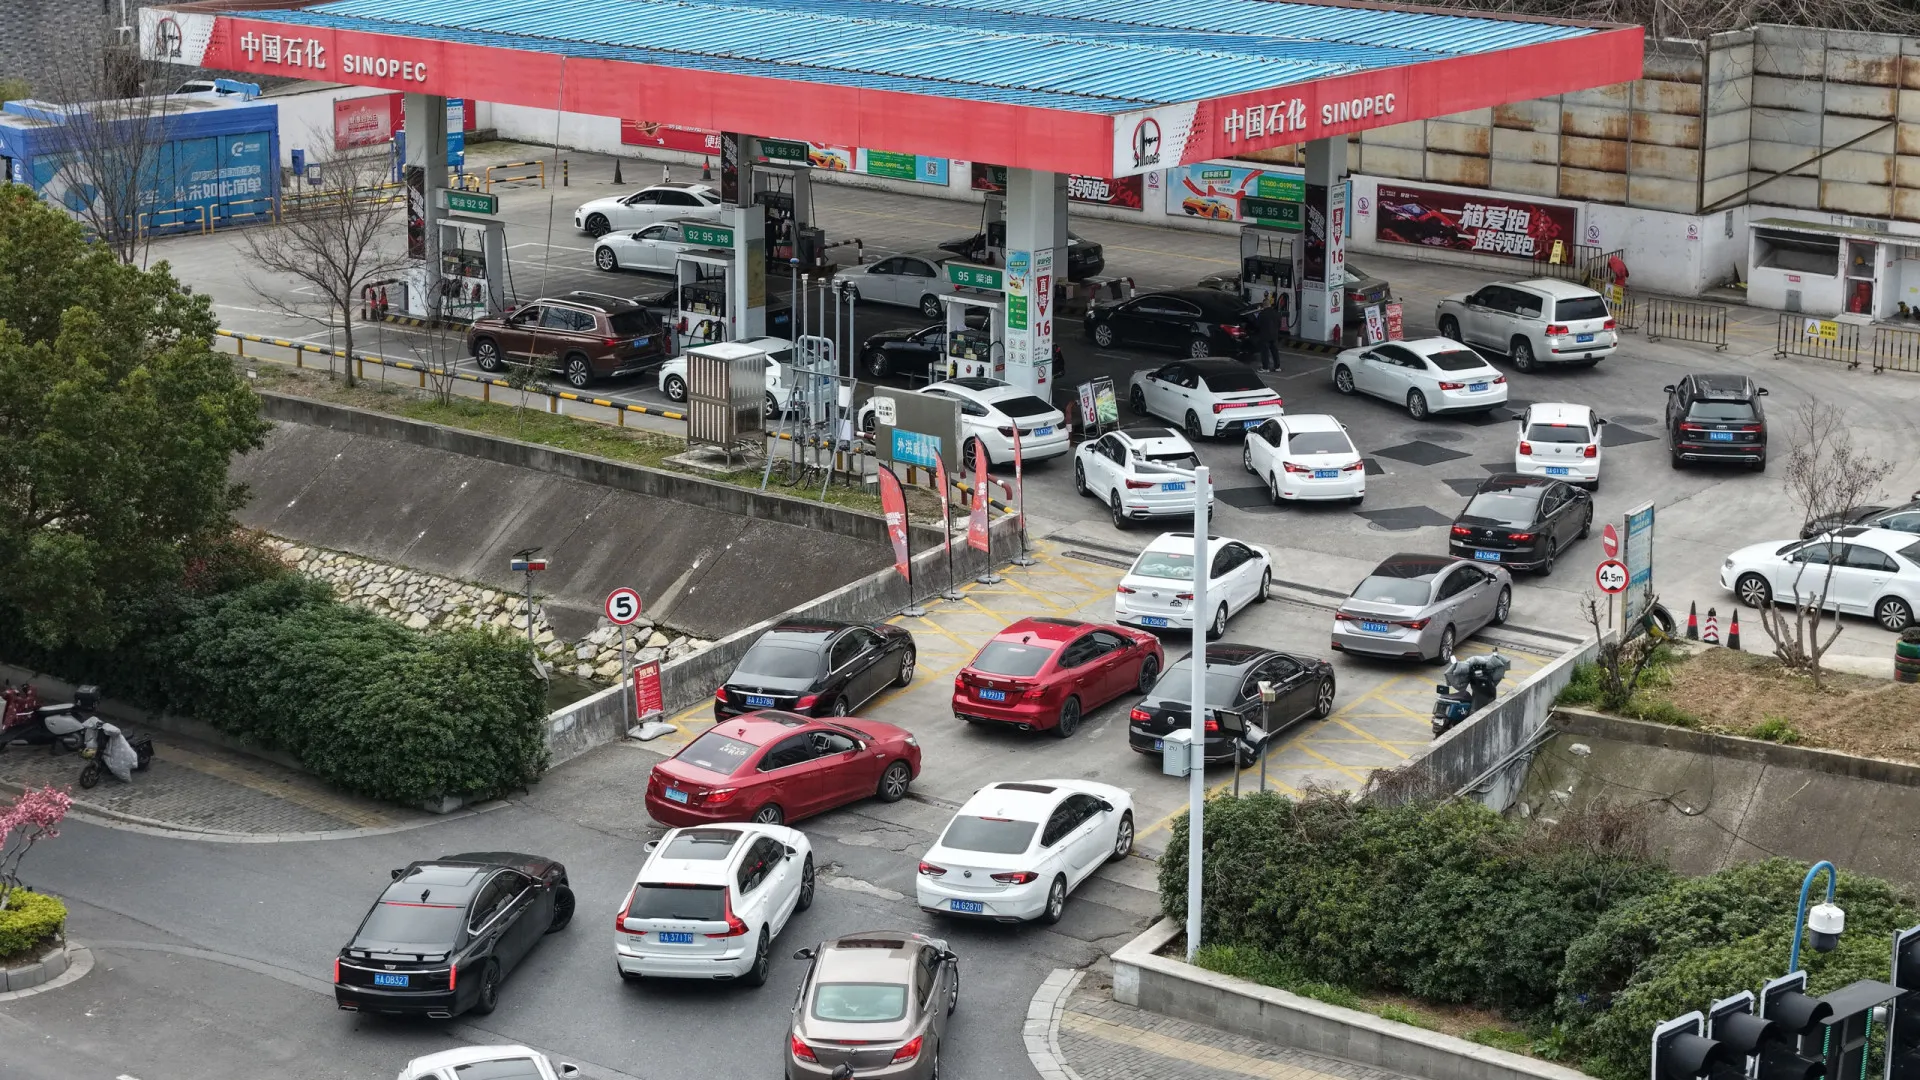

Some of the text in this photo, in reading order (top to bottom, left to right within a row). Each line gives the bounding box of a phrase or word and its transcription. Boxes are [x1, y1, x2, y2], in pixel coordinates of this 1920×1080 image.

[240, 32, 326, 69] 中国石化
[343, 54, 427, 82] SINOPEC
[1321, 93, 1395, 125] SINOPEC
[1224, 98, 1306, 142] 中国石化
[790, 148, 800, 157] 92
[467, 199, 476, 209] 92
[478, 200, 488, 210] 92
[1267, 207, 1277, 216] 95
[1282, 208, 1293, 218] 92
[1440, 202, 1530, 233] 一箱爱跑
[689, 230, 698, 240] 92
[702, 232, 712, 242] 95
[1457, 229, 1536, 256] 一路领跑
[958, 271, 969, 281] 95
[1600, 570, 1624, 582] 4.5m
[616, 597, 632, 618] 5
